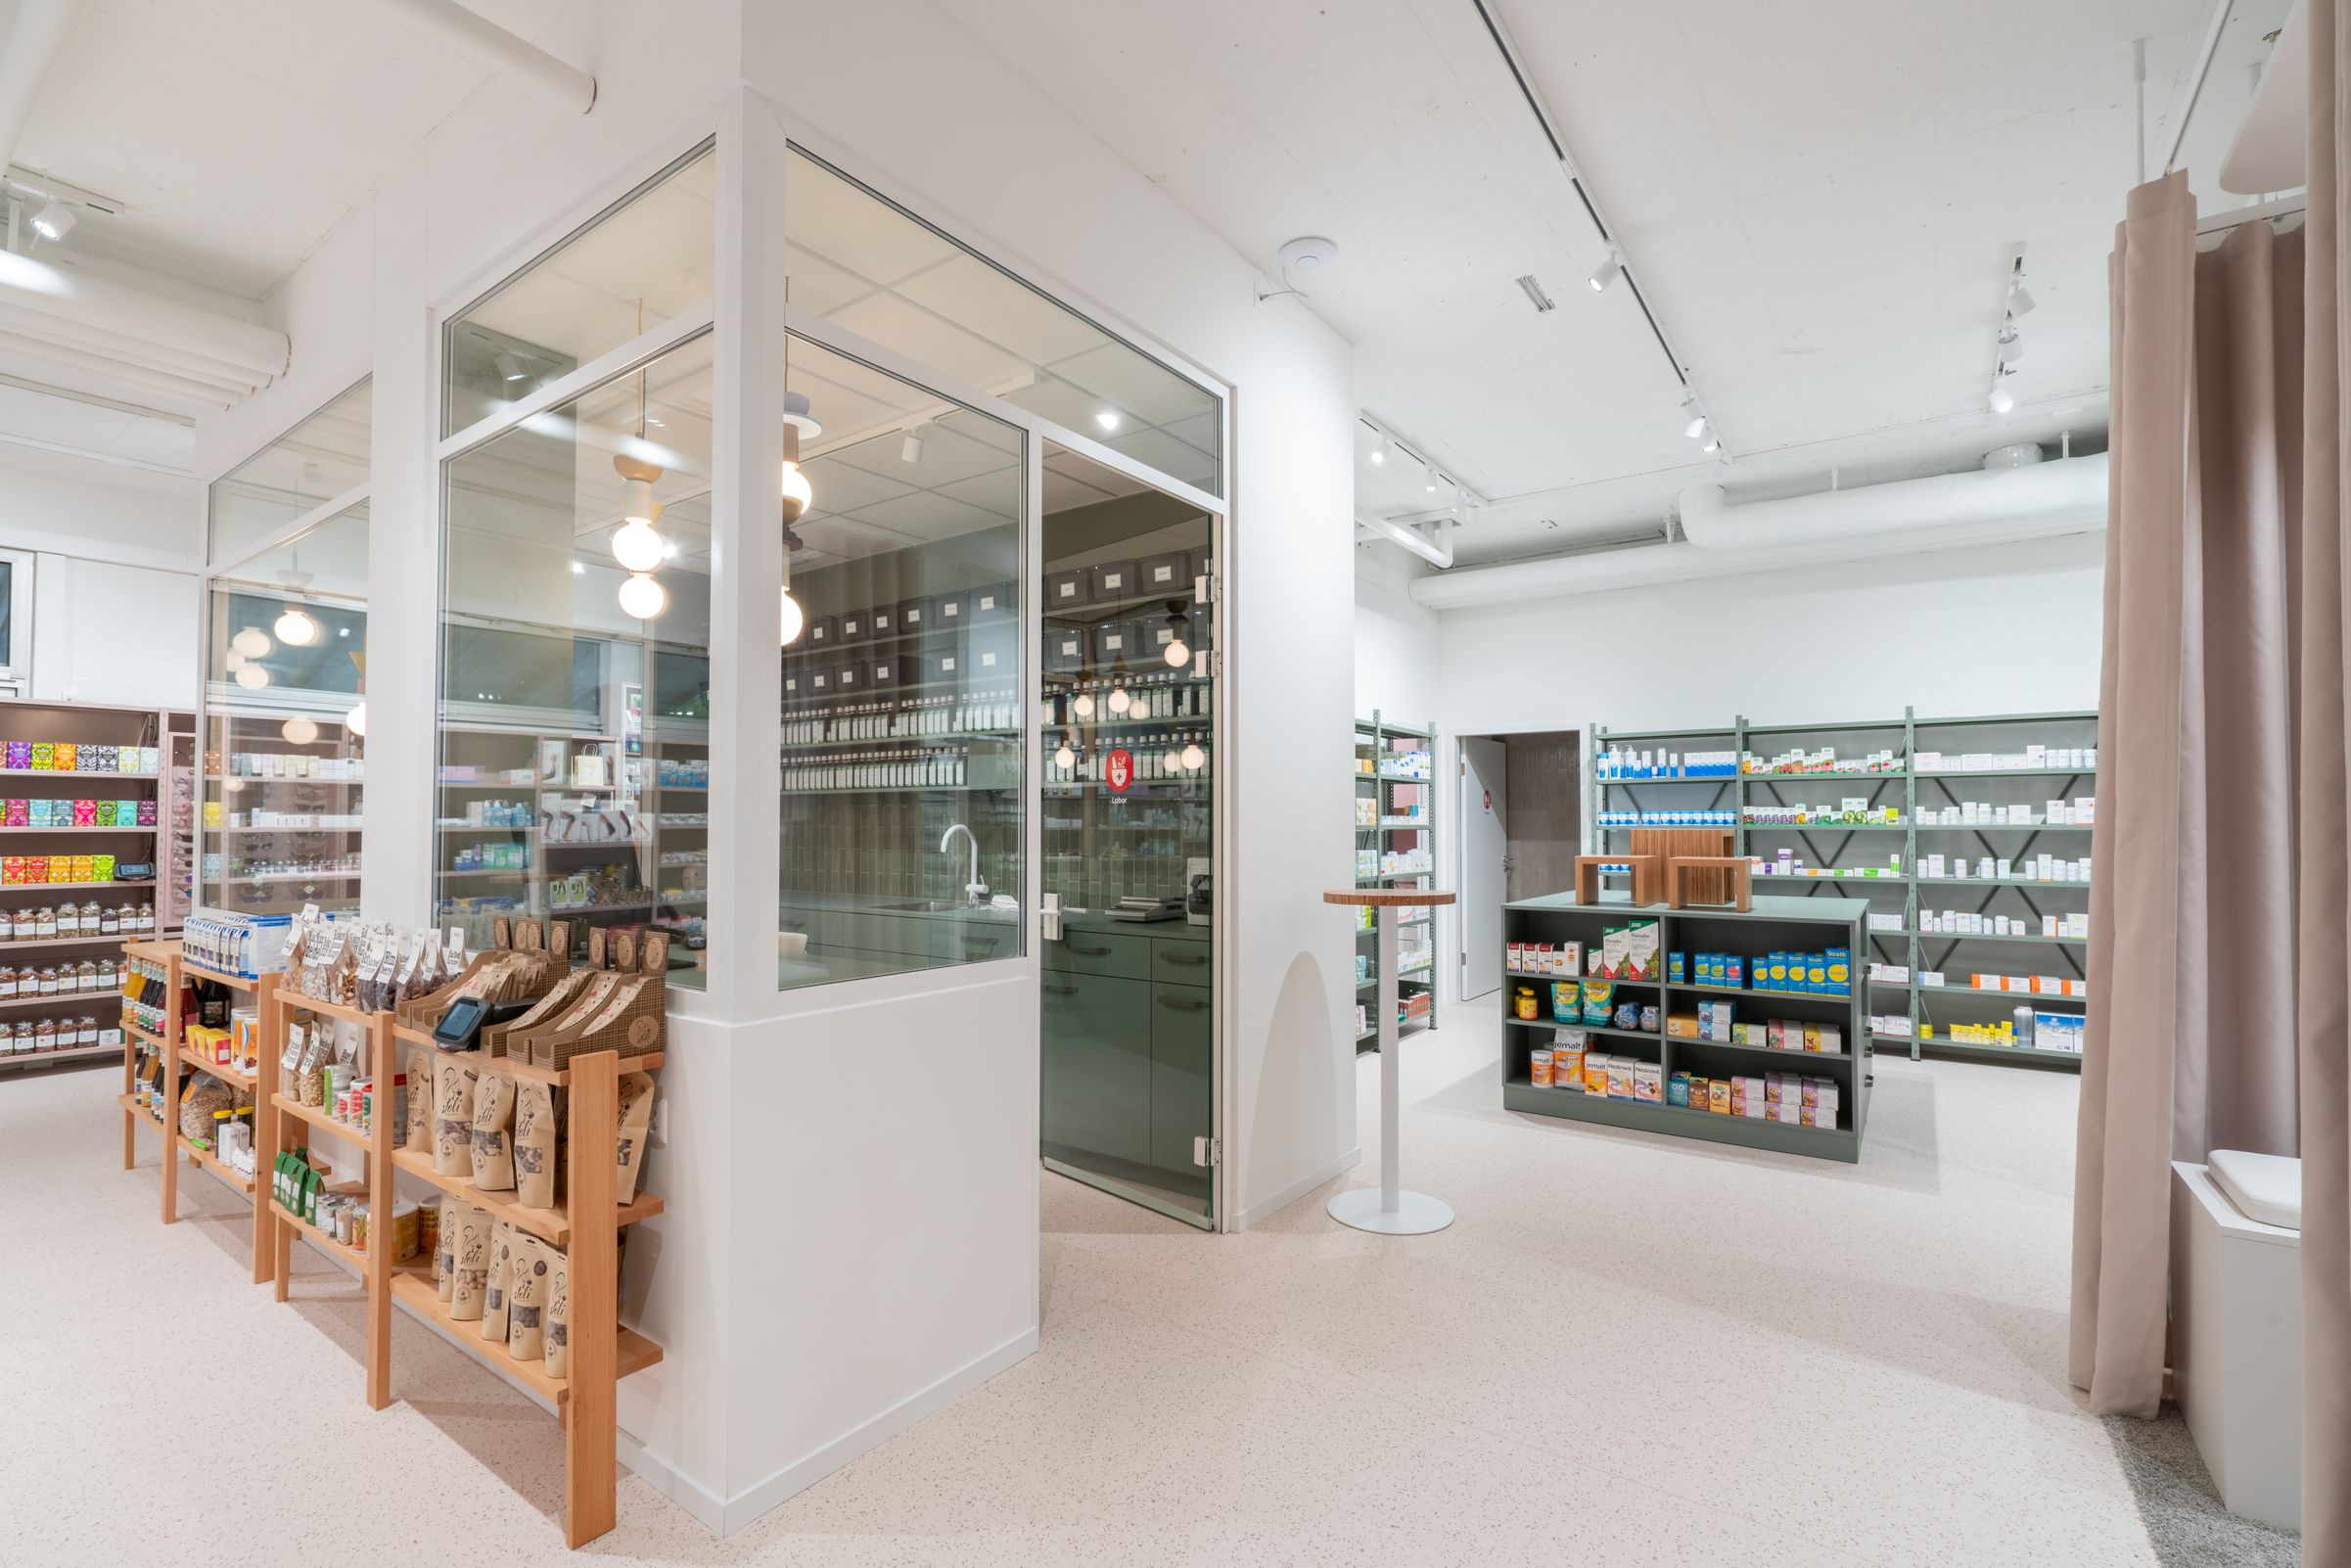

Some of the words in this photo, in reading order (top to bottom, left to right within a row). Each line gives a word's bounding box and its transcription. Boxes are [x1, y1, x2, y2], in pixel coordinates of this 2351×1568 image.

[1553, 1040, 1581, 1050] jemalt
[1586, 1062, 1606, 1071] jemalt
[1608, 1063, 1633, 1072] Nestrovit
[1636, 1066, 1660, 1075] Nestrovit
